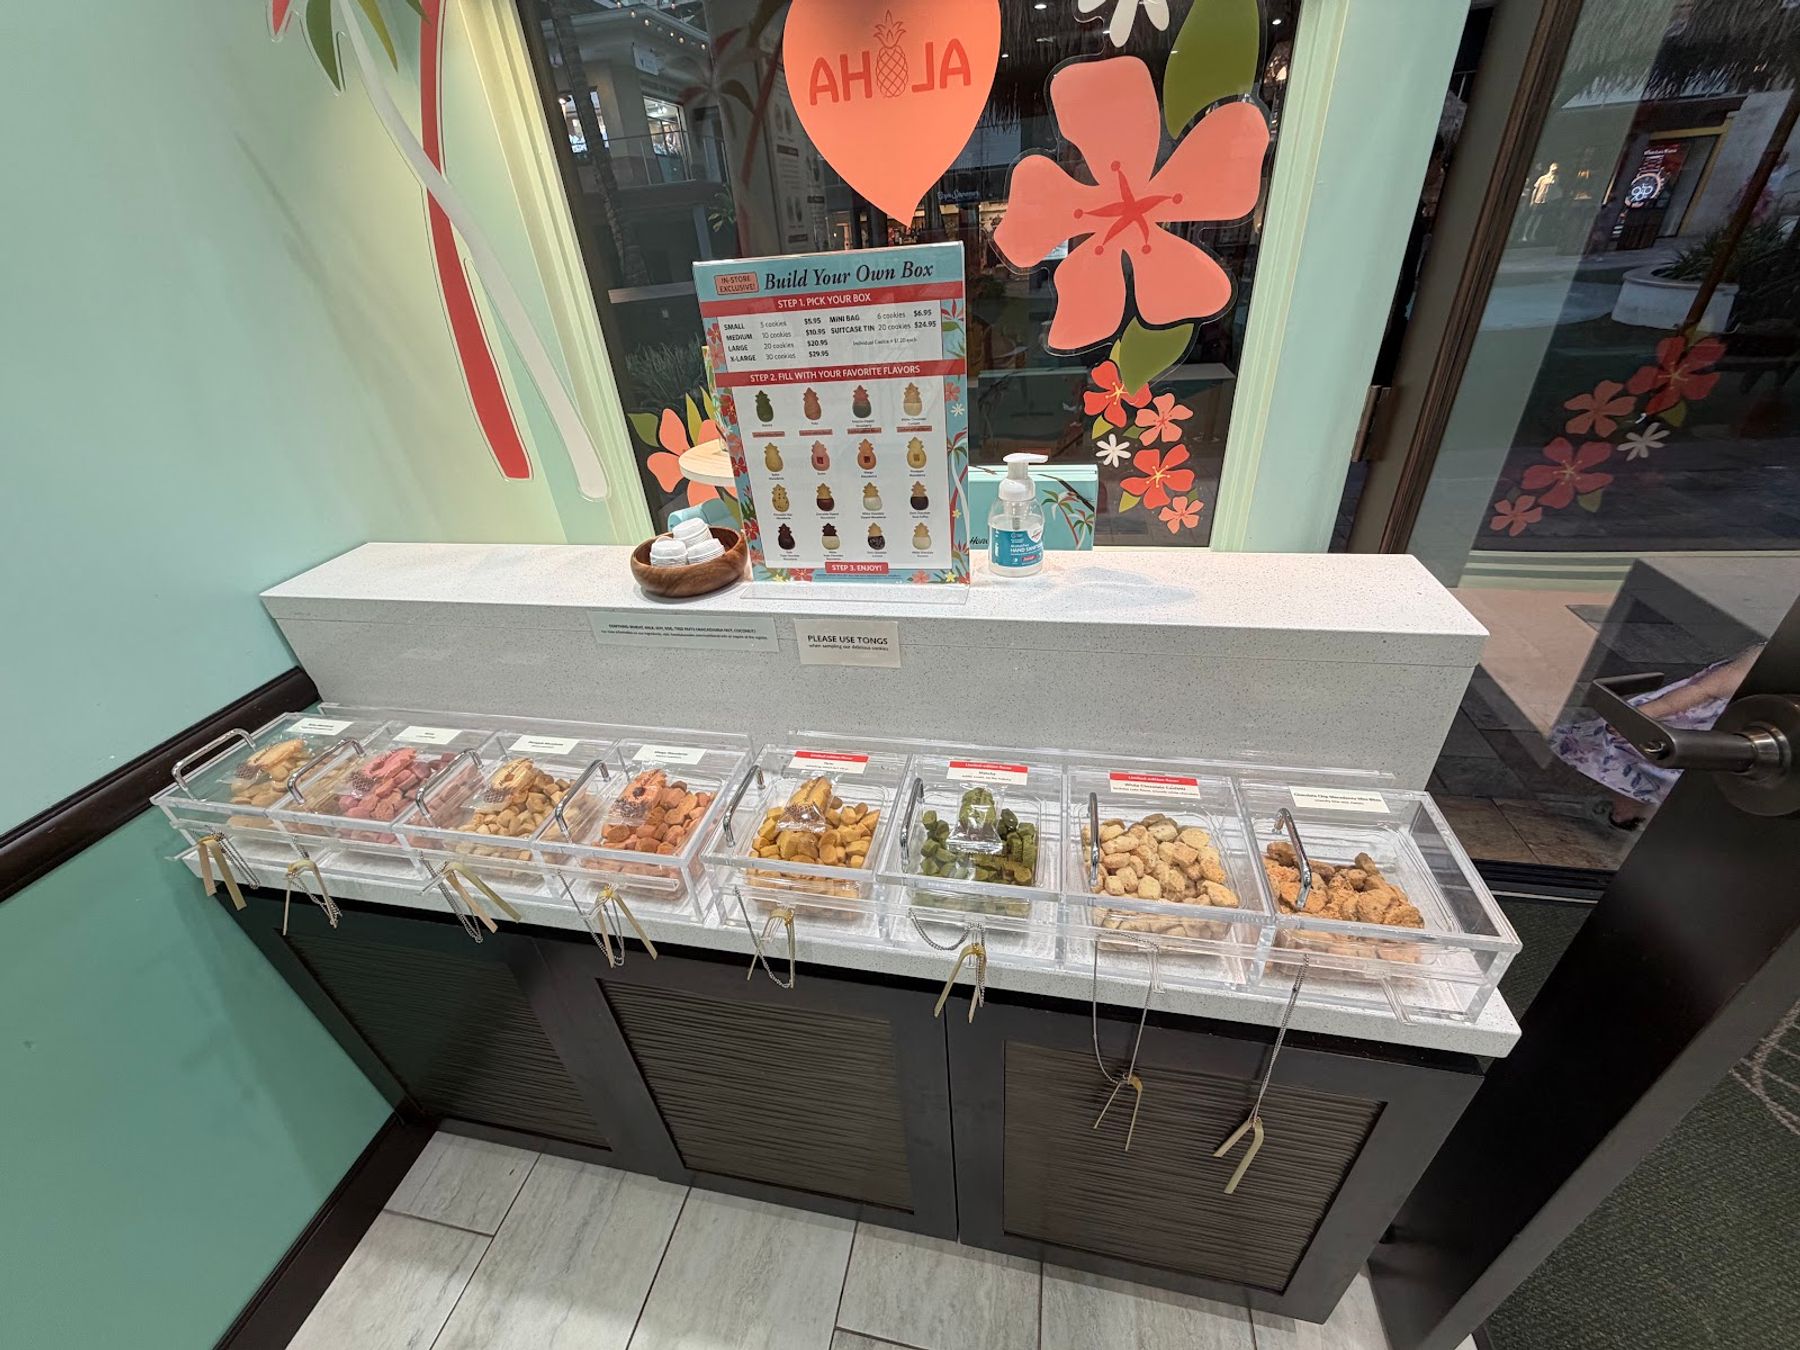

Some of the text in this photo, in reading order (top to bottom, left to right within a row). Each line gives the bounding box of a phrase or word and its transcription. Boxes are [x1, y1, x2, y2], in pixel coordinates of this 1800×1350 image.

[721, 275, 750, 284] IN-STORE
[764, 260, 934, 290] Build Your Own Box
[720, 284, 756, 292] EXCLUSIVE!
[778, 293, 871, 308] STEP 1. PICK YOUR BOX
[765, 320, 787, 328] cookies
[914, 309, 932, 317] $6.95
[806, 328, 826, 336] $10.95
[830, 326, 862, 334] SUITCASE
[914, 320, 936, 329] $24.95
[728, 344, 748, 352] LARGE
[808, 339, 828, 347] $20.95
[808, 350, 829, 358] $29.95
[750, 365, 920, 382] STEP 2. FILL WITH YOUR FAVORITE FLAVORS
[832, 564, 882, 572] STEP 3. ENJOY!
[840, 636, 856, 644] USE
[857, 636, 888, 645] TONGS
